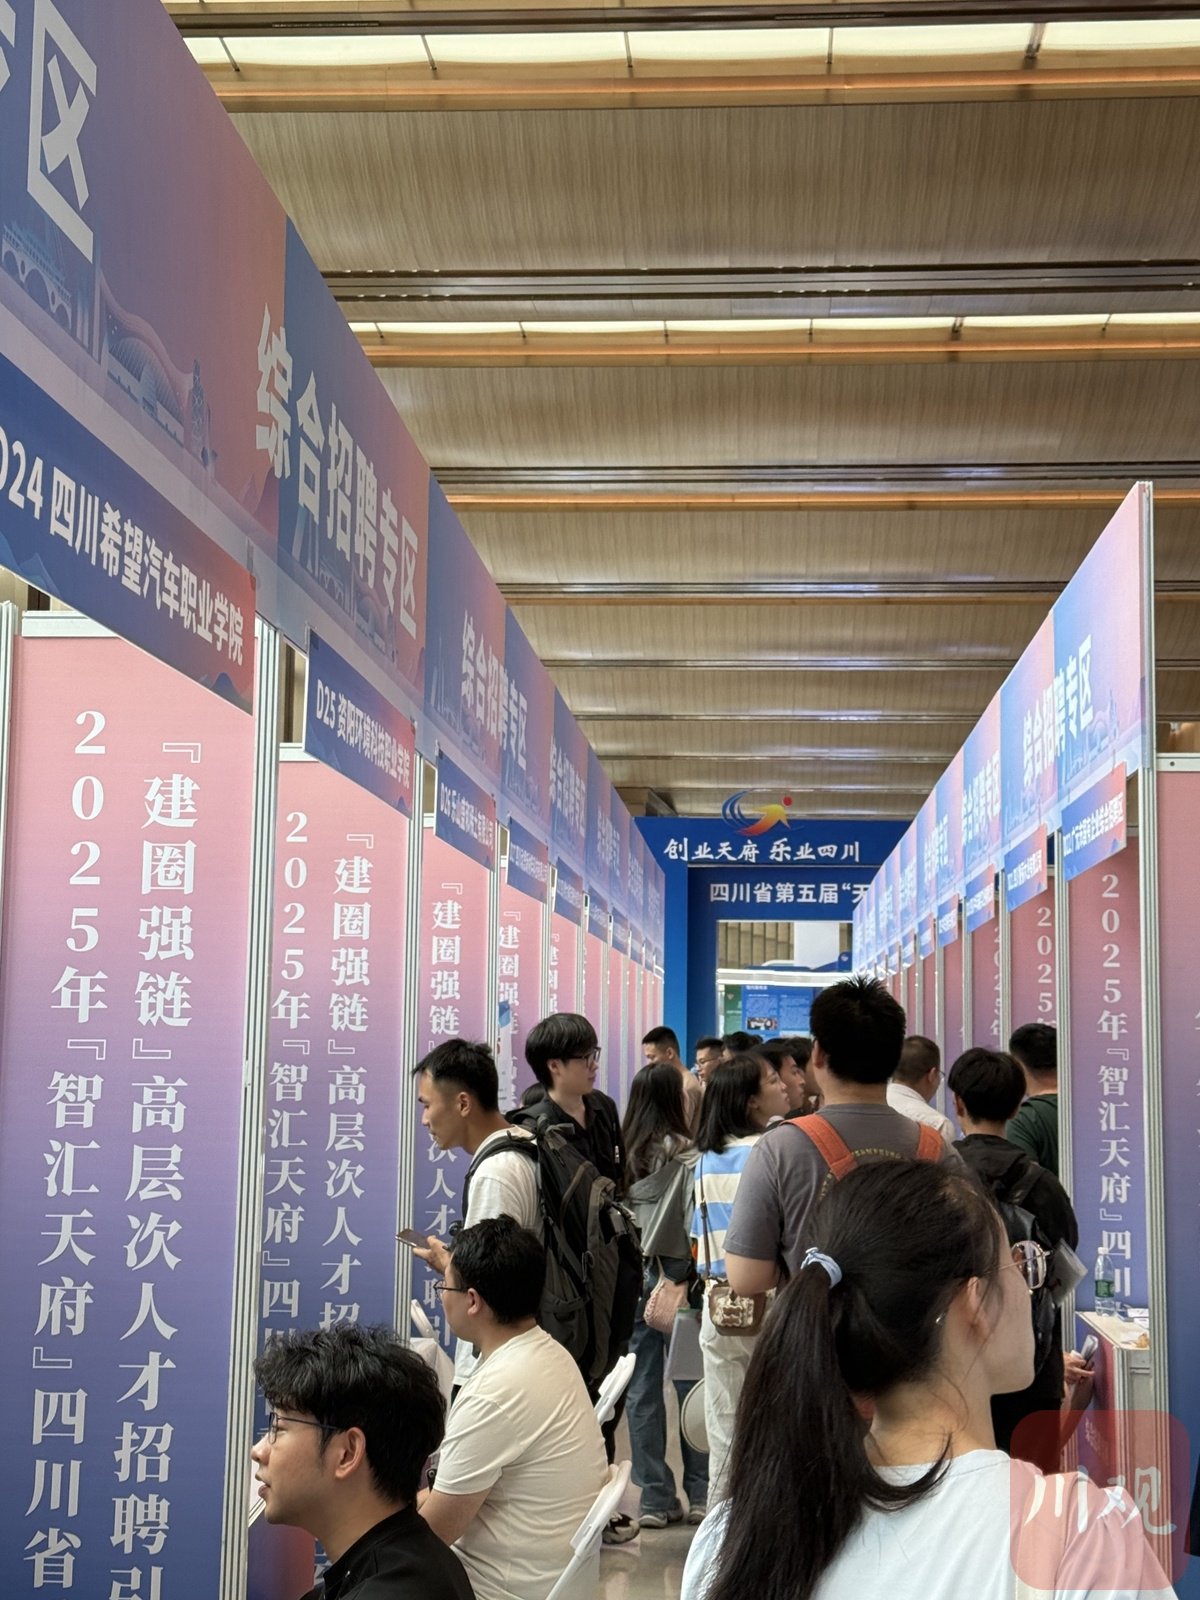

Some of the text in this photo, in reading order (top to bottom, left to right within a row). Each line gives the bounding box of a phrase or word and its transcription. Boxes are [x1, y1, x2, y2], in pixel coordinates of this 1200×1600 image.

[0, 0, 97, 264] 区
[256, 303, 418, 640] 综合招聘专区
[50, 467, 244, 665] 四川希望汽车职业学院
[316, 679, 410, 789] D25 资阳环境科技职业学院
[461, 609, 528, 771] 综合招聘专区
[1023, 634, 1094, 787] 综合招聘专区
[663, 837, 860, 864] 创业天府 乐业四川
[24, 710, 108, 1589] 2025年『智汇天府』四川省
